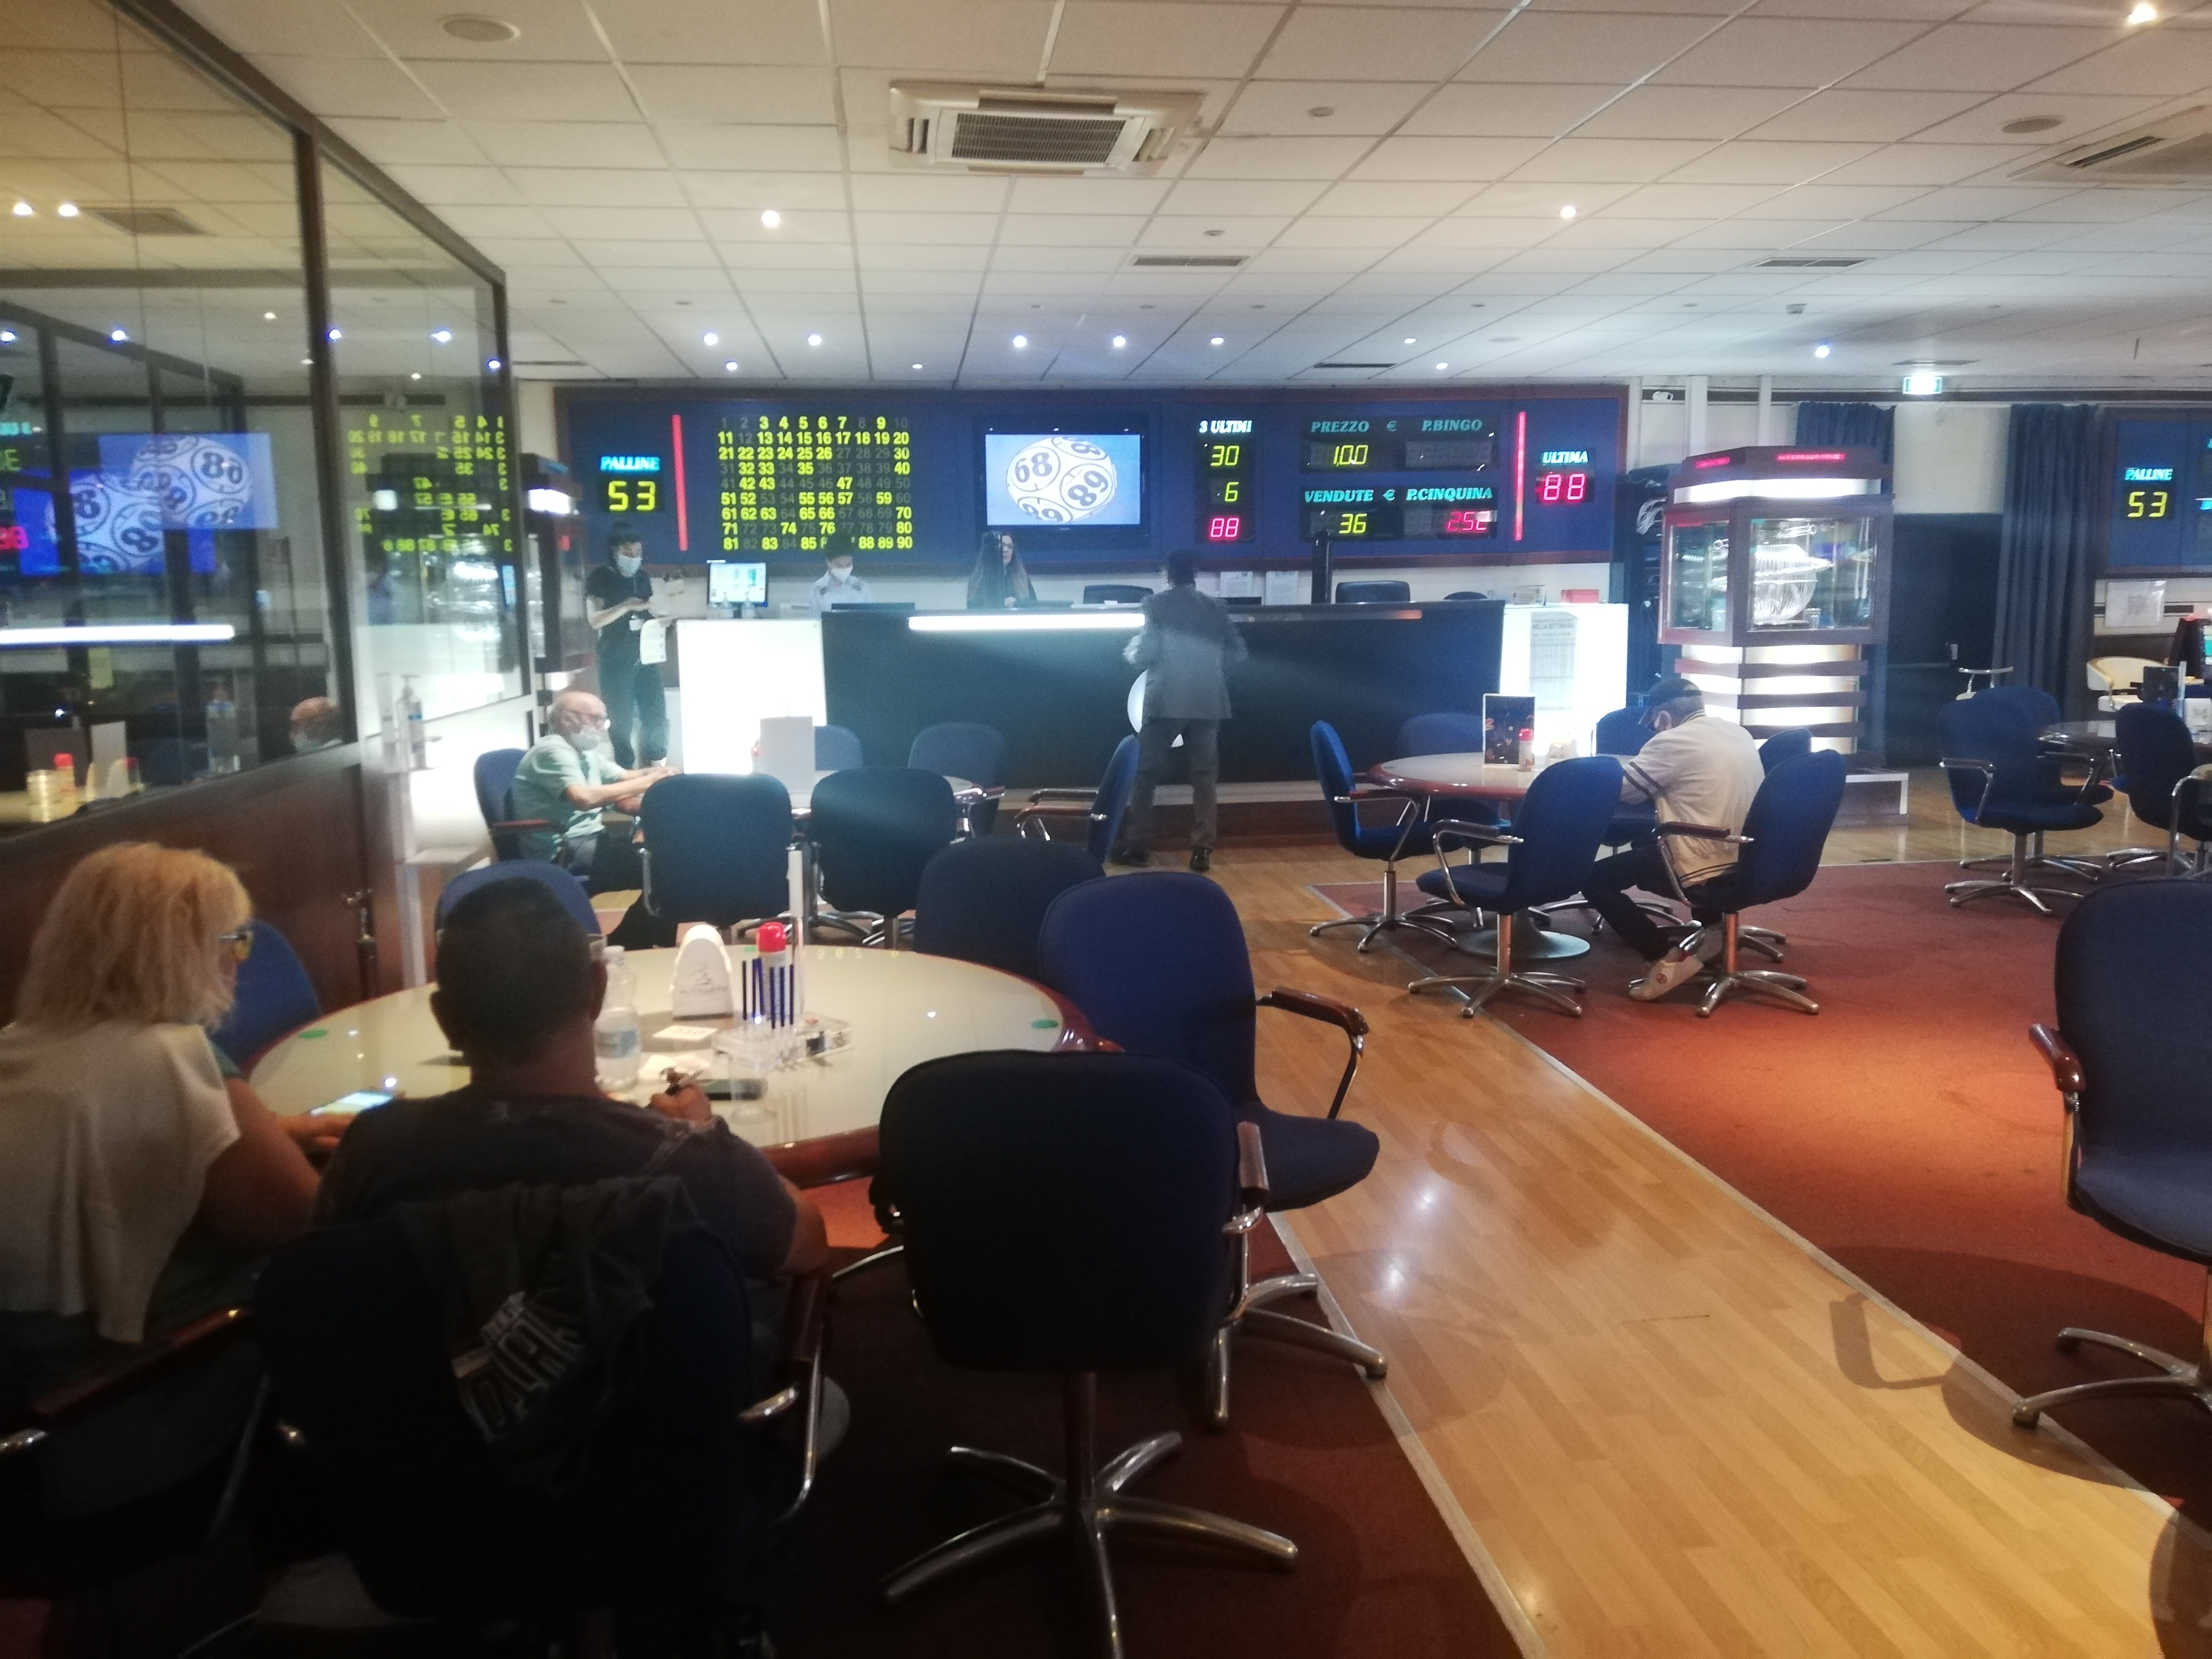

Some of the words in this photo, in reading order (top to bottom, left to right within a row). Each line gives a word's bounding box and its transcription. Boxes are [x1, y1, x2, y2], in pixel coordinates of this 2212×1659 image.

[759, 416, 769, 429] 3
[779, 416, 789, 429] 4
[799, 416, 808, 429] 5
[818, 416, 828, 429] 6
[838, 416, 847, 429] 7
[877, 416, 886, 429] 9
[1199, 421, 1208, 433] 3
[1211, 421, 1252, 433] ULTIMI
[1311, 421, 1370, 433] PREZZO
[1387, 421, 1397, 431] €
[1422, 419, 1482, 431] P.BINGO
[719, 432, 733, 445] 11
[758, 432, 773, 445] 13
[777, 432, 793, 445] 14
[797, 432, 812, 445] 15
[817, 432, 832, 445] 16
[836, 432, 851, 445] 17
[856, 432, 870, 445] 18
[875, 432, 890, 445] 19
[894, 432, 909, 445] 20
[719, 446, 734, 460] 21
[737, 446, 755, 460] 22
[757, 446, 774, 460] 23
[777, 446, 794, 460] 24
[797, 446, 813, 460] 25
[816, 446, 833, 460] 26
[895, 446, 909, 460] 30
[1211, 445, 1239, 466] 30
[1334, 445, 1369, 467] 1,00
[1542, 451, 1588, 463] ULTIMA
[601, 457, 660, 470] PALLINE
[739, 461, 755, 475] 32
[758, 461, 775, 475] 33
[797, 461, 814, 475] 35
[894, 461, 910, 475] 40
[1015, 452, 1052, 483] 68
[2125, 469, 2173, 481] PALLINE
[739, 477, 756, 490] 42
[759, 477, 775, 490] 43
[837, 477, 853, 490] 47
[1544, 474, 1585, 500] 88
[608, 481, 655, 510] 53
[721, 492, 736, 505] 51
[740, 492, 756, 505] 52
[799, 492, 815, 505] 55
[818, 492, 834, 505] 56
[838, 492, 853, 505] 57
[877, 492, 892, 505] 59
[1225, 482, 1238, 502] 6
[1304, 490, 1373, 503] VENDUTE
[1383, 490, 1395, 501] €
[1406, 487, 1493, 501] P.CINQUINA
[2128, 492, 2167, 517] 53
[722, 507, 737, 520] 61
[740, 507, 757, 520] 62
[759, 507, 777, 520] 63
[799, 507, 816, 520] 65
[818, 507, 835, 520] 66
[897, 507, 912, 520] 70
[723, 521, 738, 535] 71
[781, 521, 797, 535] 74
[820, 521, 835, 535] 76
[896, 521, 912, 535] 80
[1211, 518, 1239, 537] 88
[1339, 514, 1367, 534] 36
[723, 536, 738, 550] 81
[762, 536, 778, 550] 83
[801, 536, 817, 550] 85
[859, 536, 875, 550] 88
[878, 536, 894, 550] 89
[897, 536, 912, 550] 90
